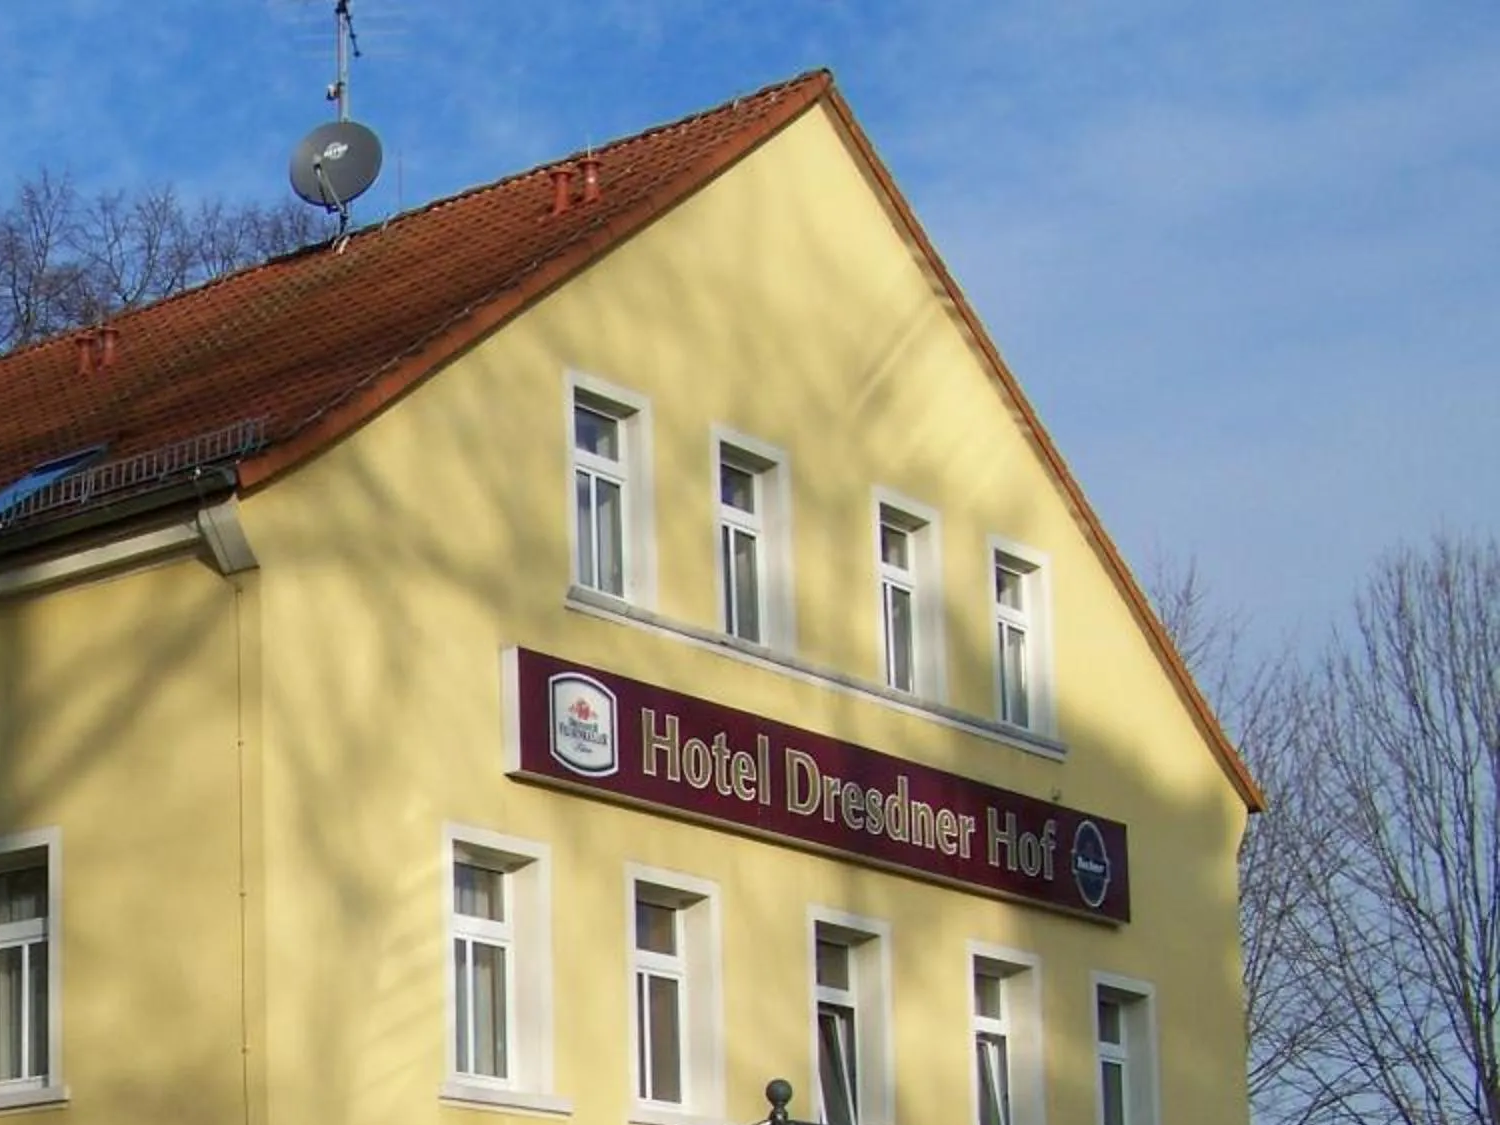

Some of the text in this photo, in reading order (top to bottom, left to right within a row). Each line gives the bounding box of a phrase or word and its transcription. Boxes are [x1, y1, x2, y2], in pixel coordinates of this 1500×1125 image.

[641, 706, 1057, 881] Hotel Dresdner Hof
